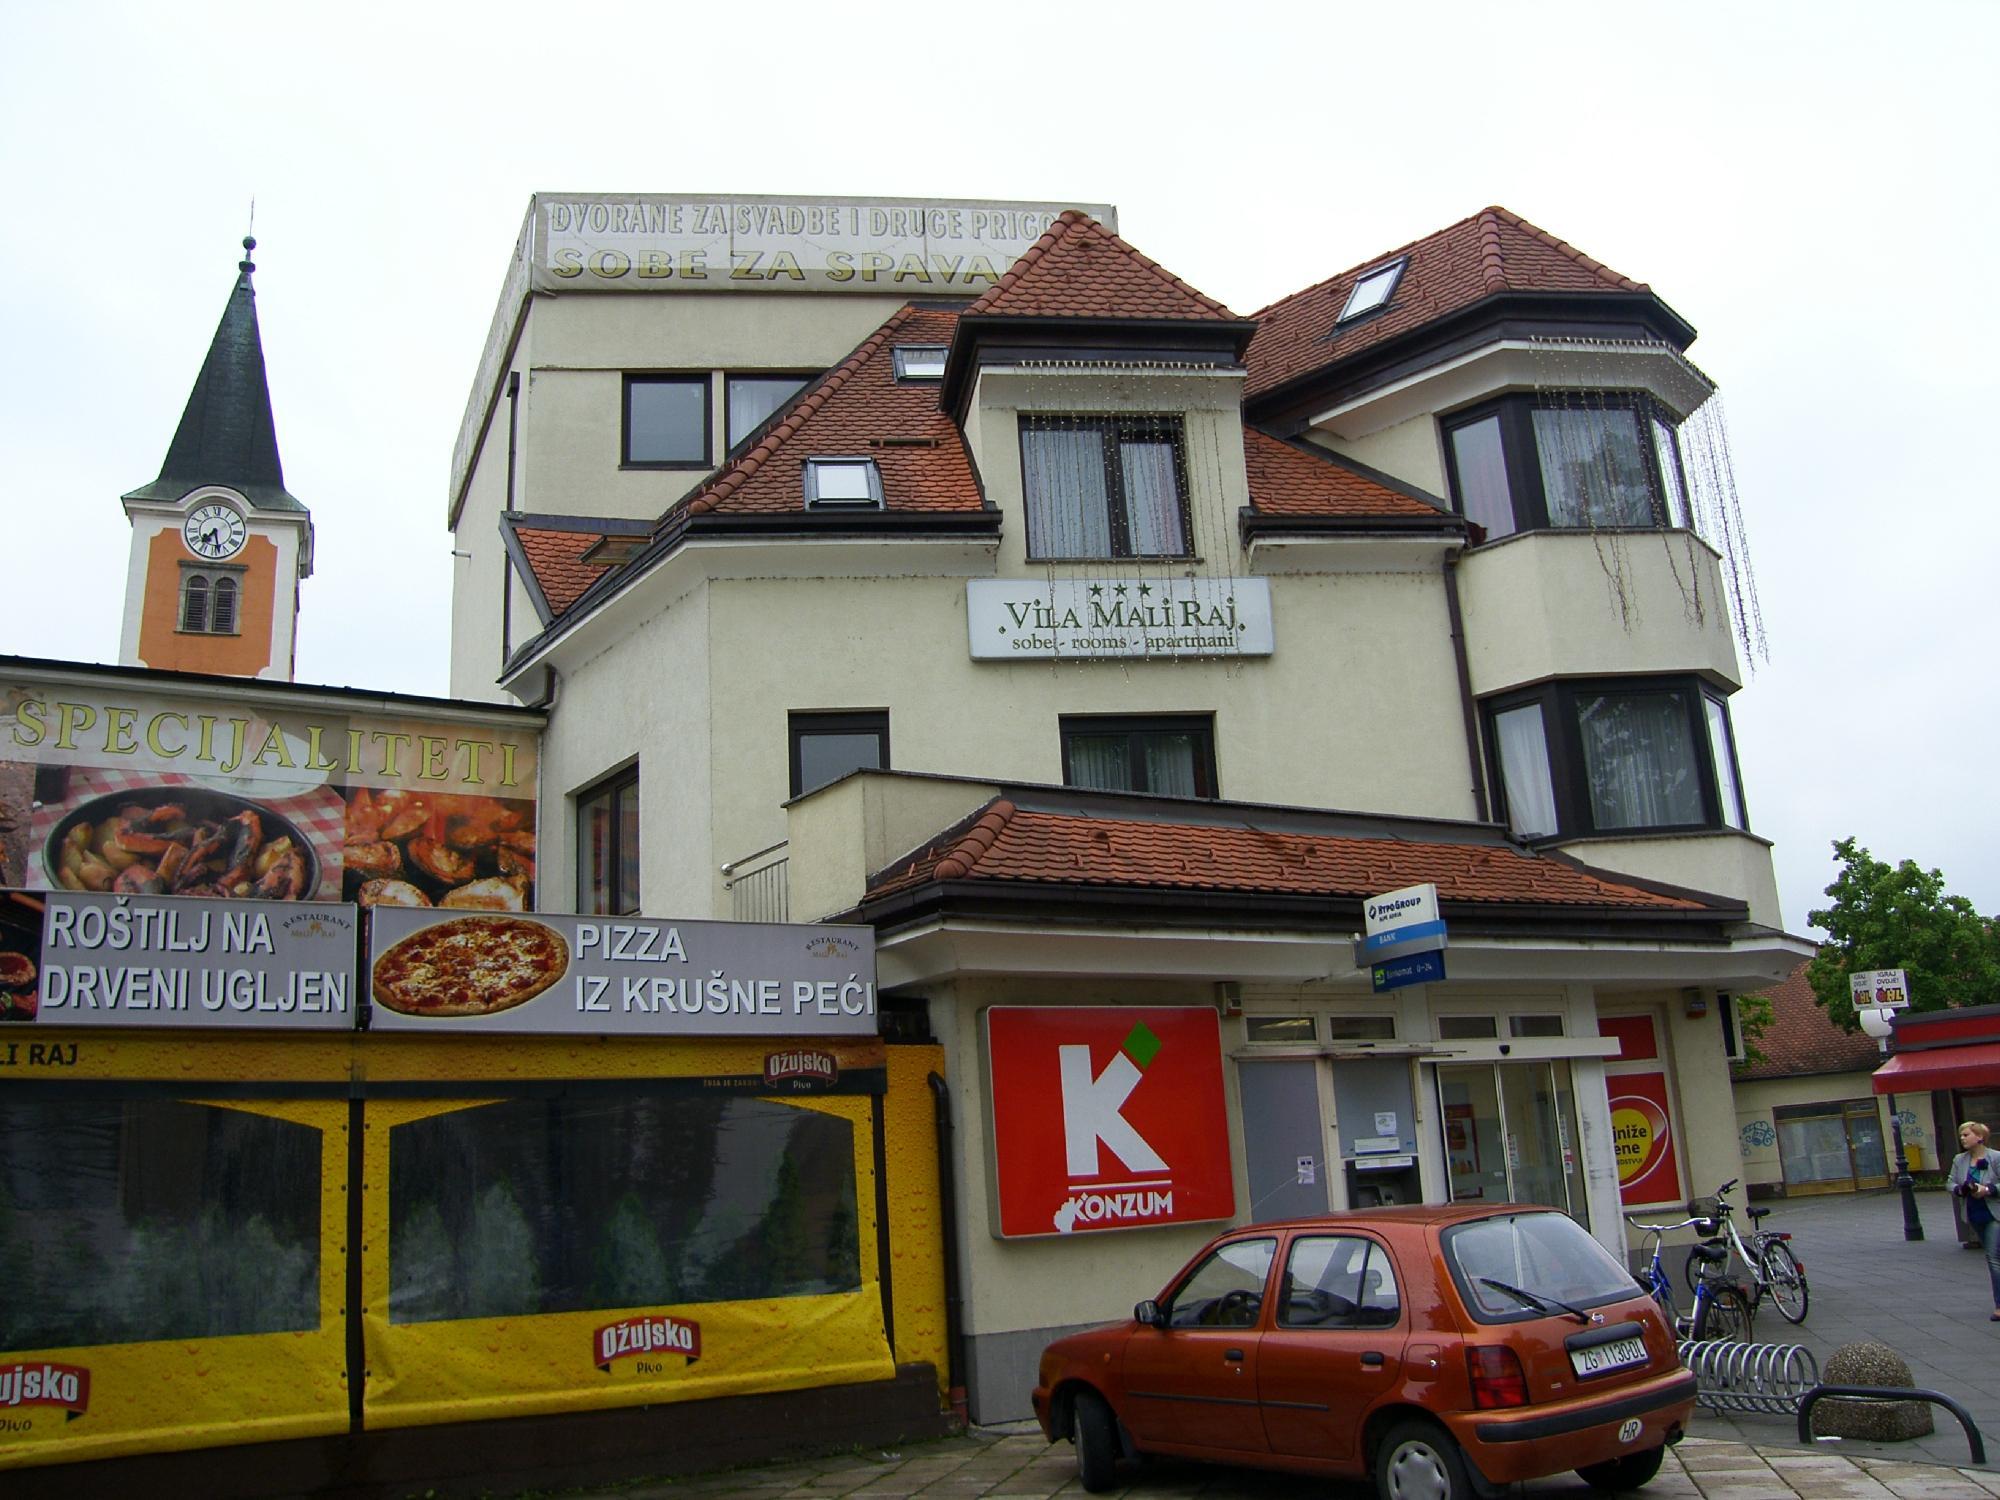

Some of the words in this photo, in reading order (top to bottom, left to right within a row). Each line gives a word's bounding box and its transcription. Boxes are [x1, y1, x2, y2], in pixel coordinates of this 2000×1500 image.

[552, 203, 683, 234] DVORANE
[693, 205, 727, 235] ZA
[737, 205, 840, 236] SVADBE
[851, 208, 860, 236] I
[870, 208, 963, 240] DRUGE
[552, 248, 708, 280] SOBE
[729, 250, 807, 281] ZA
[1012, 634, 1053, 650] sobe
[1072, 638, 1127, 650] rooms
[1146, 632, 1235, 653] apartmani
[13, 699, 519, 787] SPECIJALITETI
[49, 896, 211, 953] ROŠTILJ
[222, 911, 276, 954] NA
[282, 913, 352, 931] RESTAURANT
[576, 924, 689, 963] PIZZA
[41, 964, 190, 1010] DRVENI
[200, 968, 348, 1013] UGLJEN
[576, 975, 611, 1012] IZ
[622, 970, 782, 1015] KRUŠNE
[793, 973, 875, 1016] PEĆI
[30, 1043, 78, 1066] RAJ
[769, 1050, 832, 1076] Ožujsko
[1059, 1045, 1171, 1176] K
[1070, 1191, 1173, 1222] KONZUM
[602, 1318, 693, 1359] Ožujsko
[1580, 1350, 1598, 1371] ZG
[1621, 1420, 1639, 1441] HR
